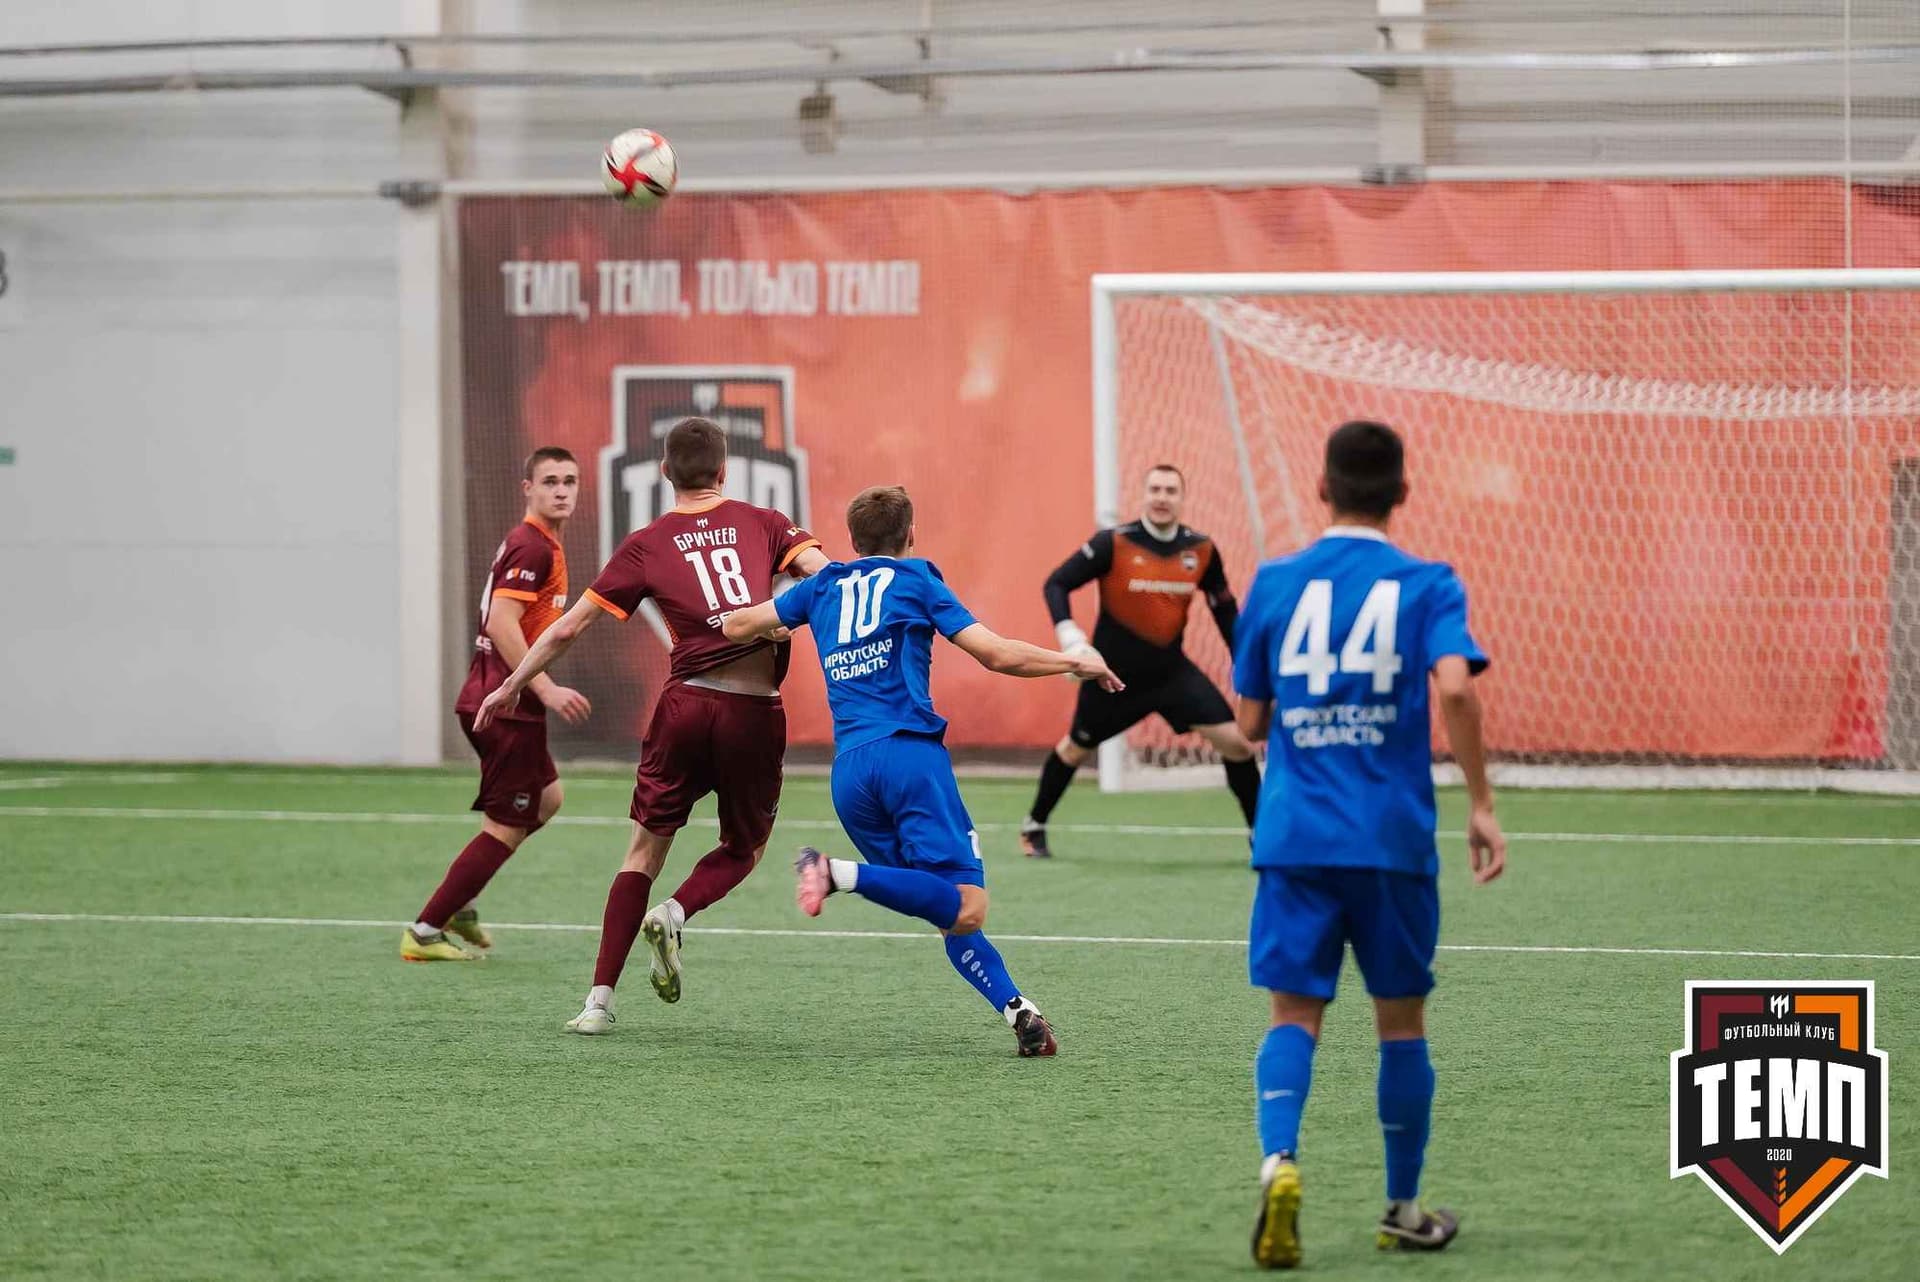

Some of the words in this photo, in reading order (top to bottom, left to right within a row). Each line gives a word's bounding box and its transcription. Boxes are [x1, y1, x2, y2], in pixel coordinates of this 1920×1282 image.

[501, 261, 589, 322] ТЕМП,
[597, 260, 691, 319] ТЕМП,
[697, 259, 818, 316] ТОЛЬКО
[673, 527, 737, 552] БРИЧЕЕВ
[684, 547, 751, 611] 18
[835, 567, 896, 644] 10
[824, 638, 894, 669] ИРКУТСКАЯ
[830, 655, 889, 681] ОБЛАСТЬ
[1279, 578, 1403, 695] 44
